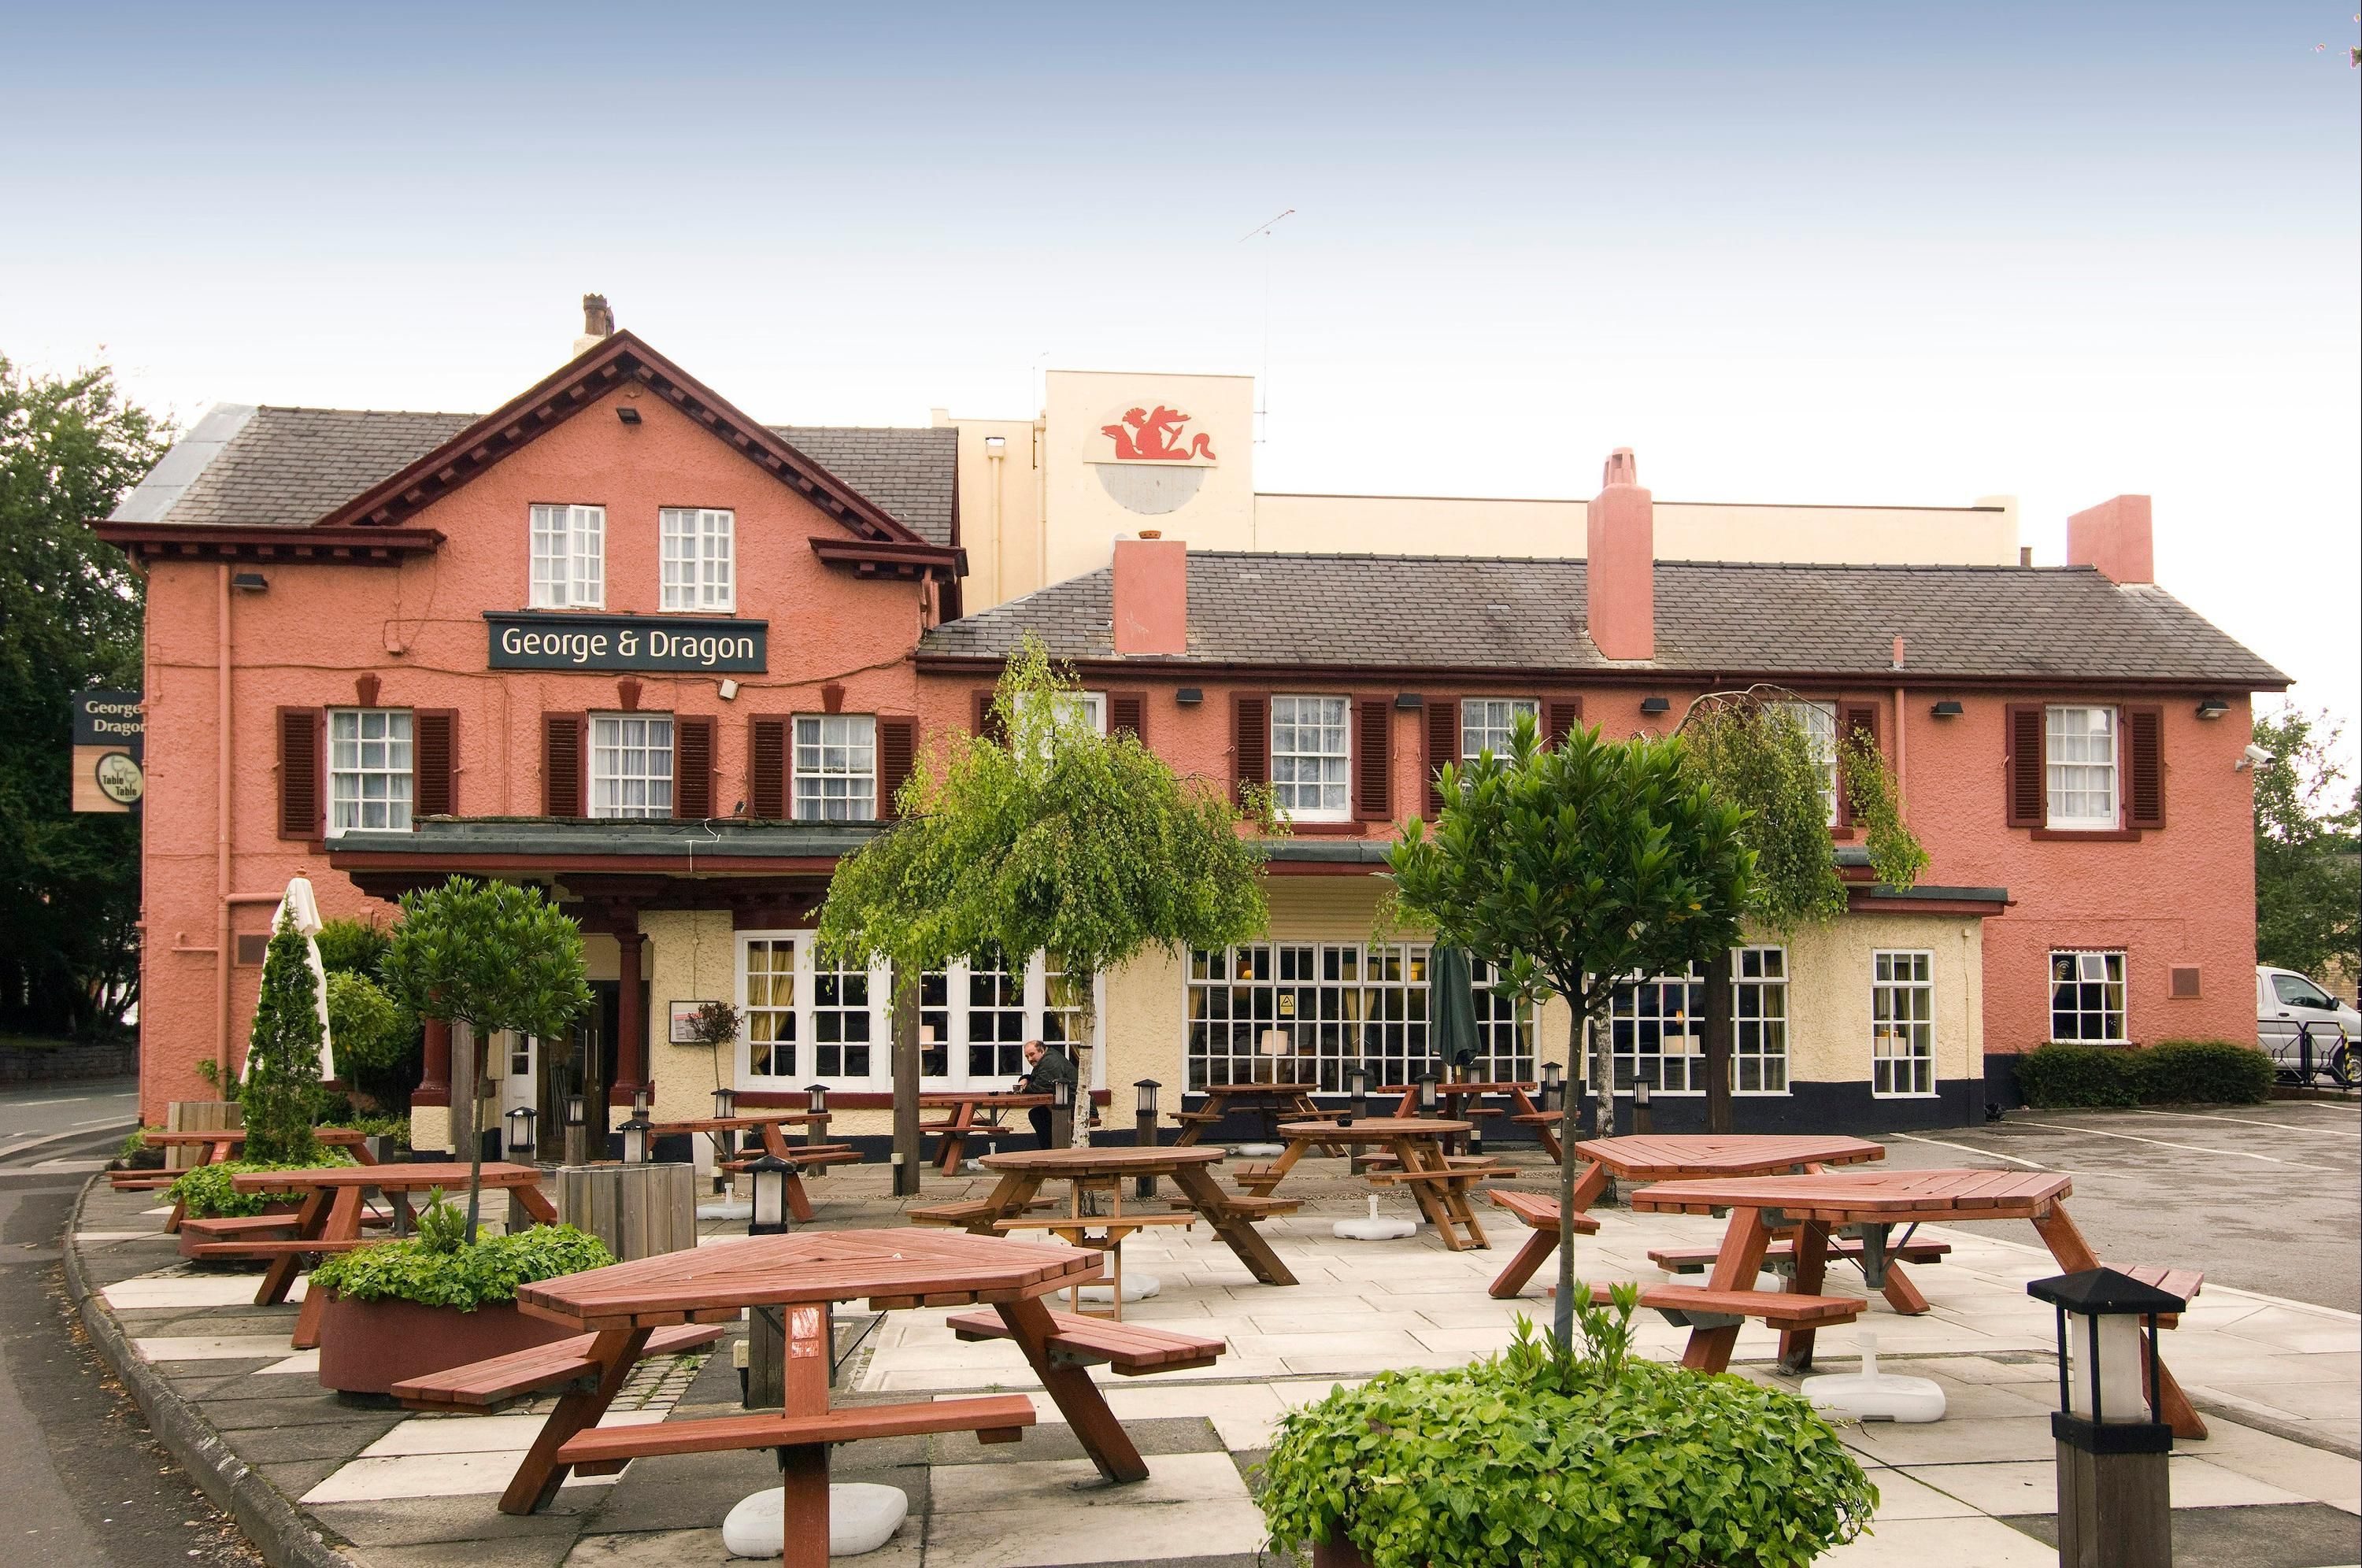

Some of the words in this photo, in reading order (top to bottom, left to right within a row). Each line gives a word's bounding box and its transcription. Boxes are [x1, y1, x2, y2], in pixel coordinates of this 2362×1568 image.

[502, 627, 608, 664] George
[617, 629, 639, 657] &
[650, 631, 753, 666] Dragon
[85, 700, 142, 719] George
[102, 772, 124, 785] Table
[116, 783, 137, 796] Table
